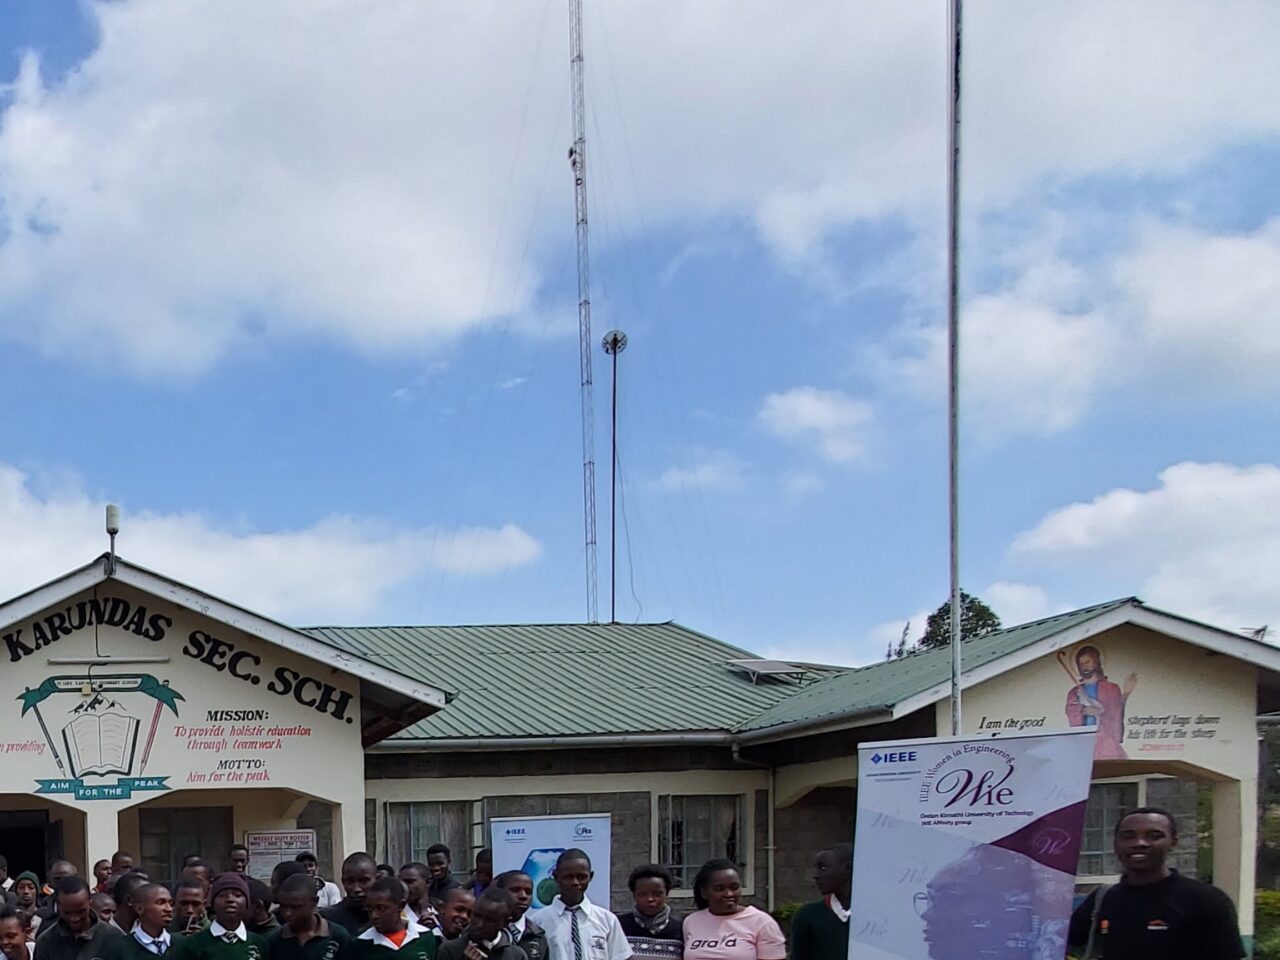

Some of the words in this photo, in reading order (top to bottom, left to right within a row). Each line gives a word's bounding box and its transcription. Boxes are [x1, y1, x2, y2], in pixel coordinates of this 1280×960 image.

[2, 597, 173, 662] KARUNDAS
[182, 630, 261, 685] SEC.
[267, 666, 354, 724] SCH.
[206, 710, 269, 721] MISSION:
[978, 716, 987, 729] I
[986, 721, 1002, 729] am
[1004, 717, 1020, 728] the
[1018, 716, 1048, 731] good
[174, 726, 187, 737] To
[188, 725, 225, 739] provide
[229, 725, 265, 737] holistic
[266, 725, 312, 737] education
[187, 739, 228, 753] through
[232, 739, 282, 750] teamwork
[217, 759, 266, 770] MOTTO:
[884, 752, 918, 763] IEEE
[925, 754, 952, 779] Women
[953, 750, 962, 758] in
[963, 744, 1016, 764] Engineering
[186, 771, 206, 783] Aim
[208, 771, 225, 783] for
[226, 770, 243, 782] the
[936, 764, 1014, 808] Wie
